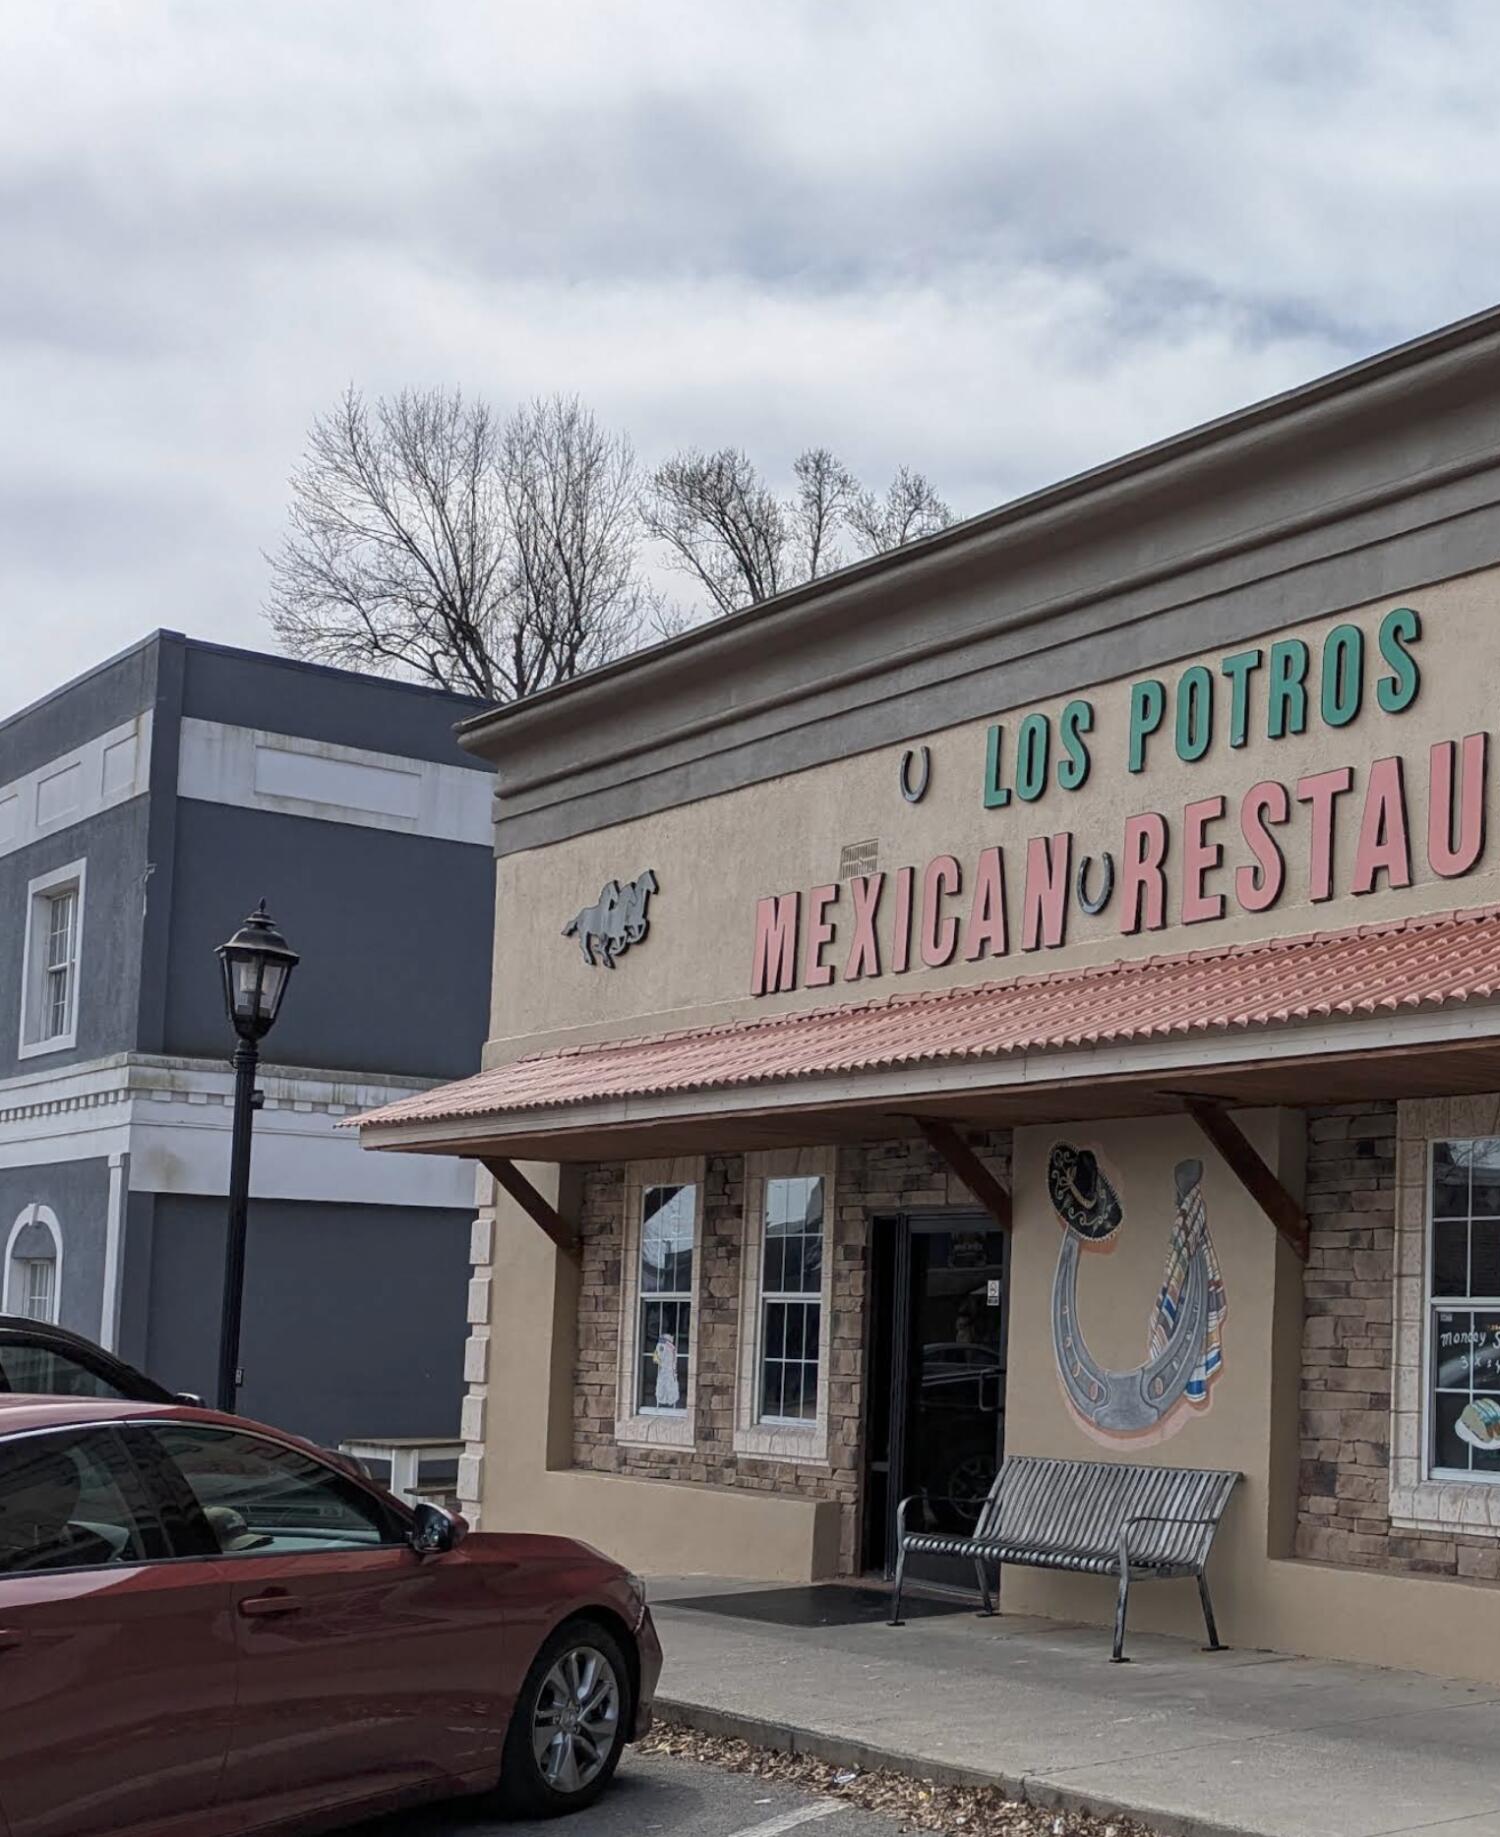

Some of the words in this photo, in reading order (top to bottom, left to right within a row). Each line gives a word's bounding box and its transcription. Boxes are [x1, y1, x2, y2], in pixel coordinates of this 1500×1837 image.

[983, 701, 1093, 808] LOS
[1128, 607, 1421, 773] POTROS
[751, 831, 1073, 997] MEXICAN
